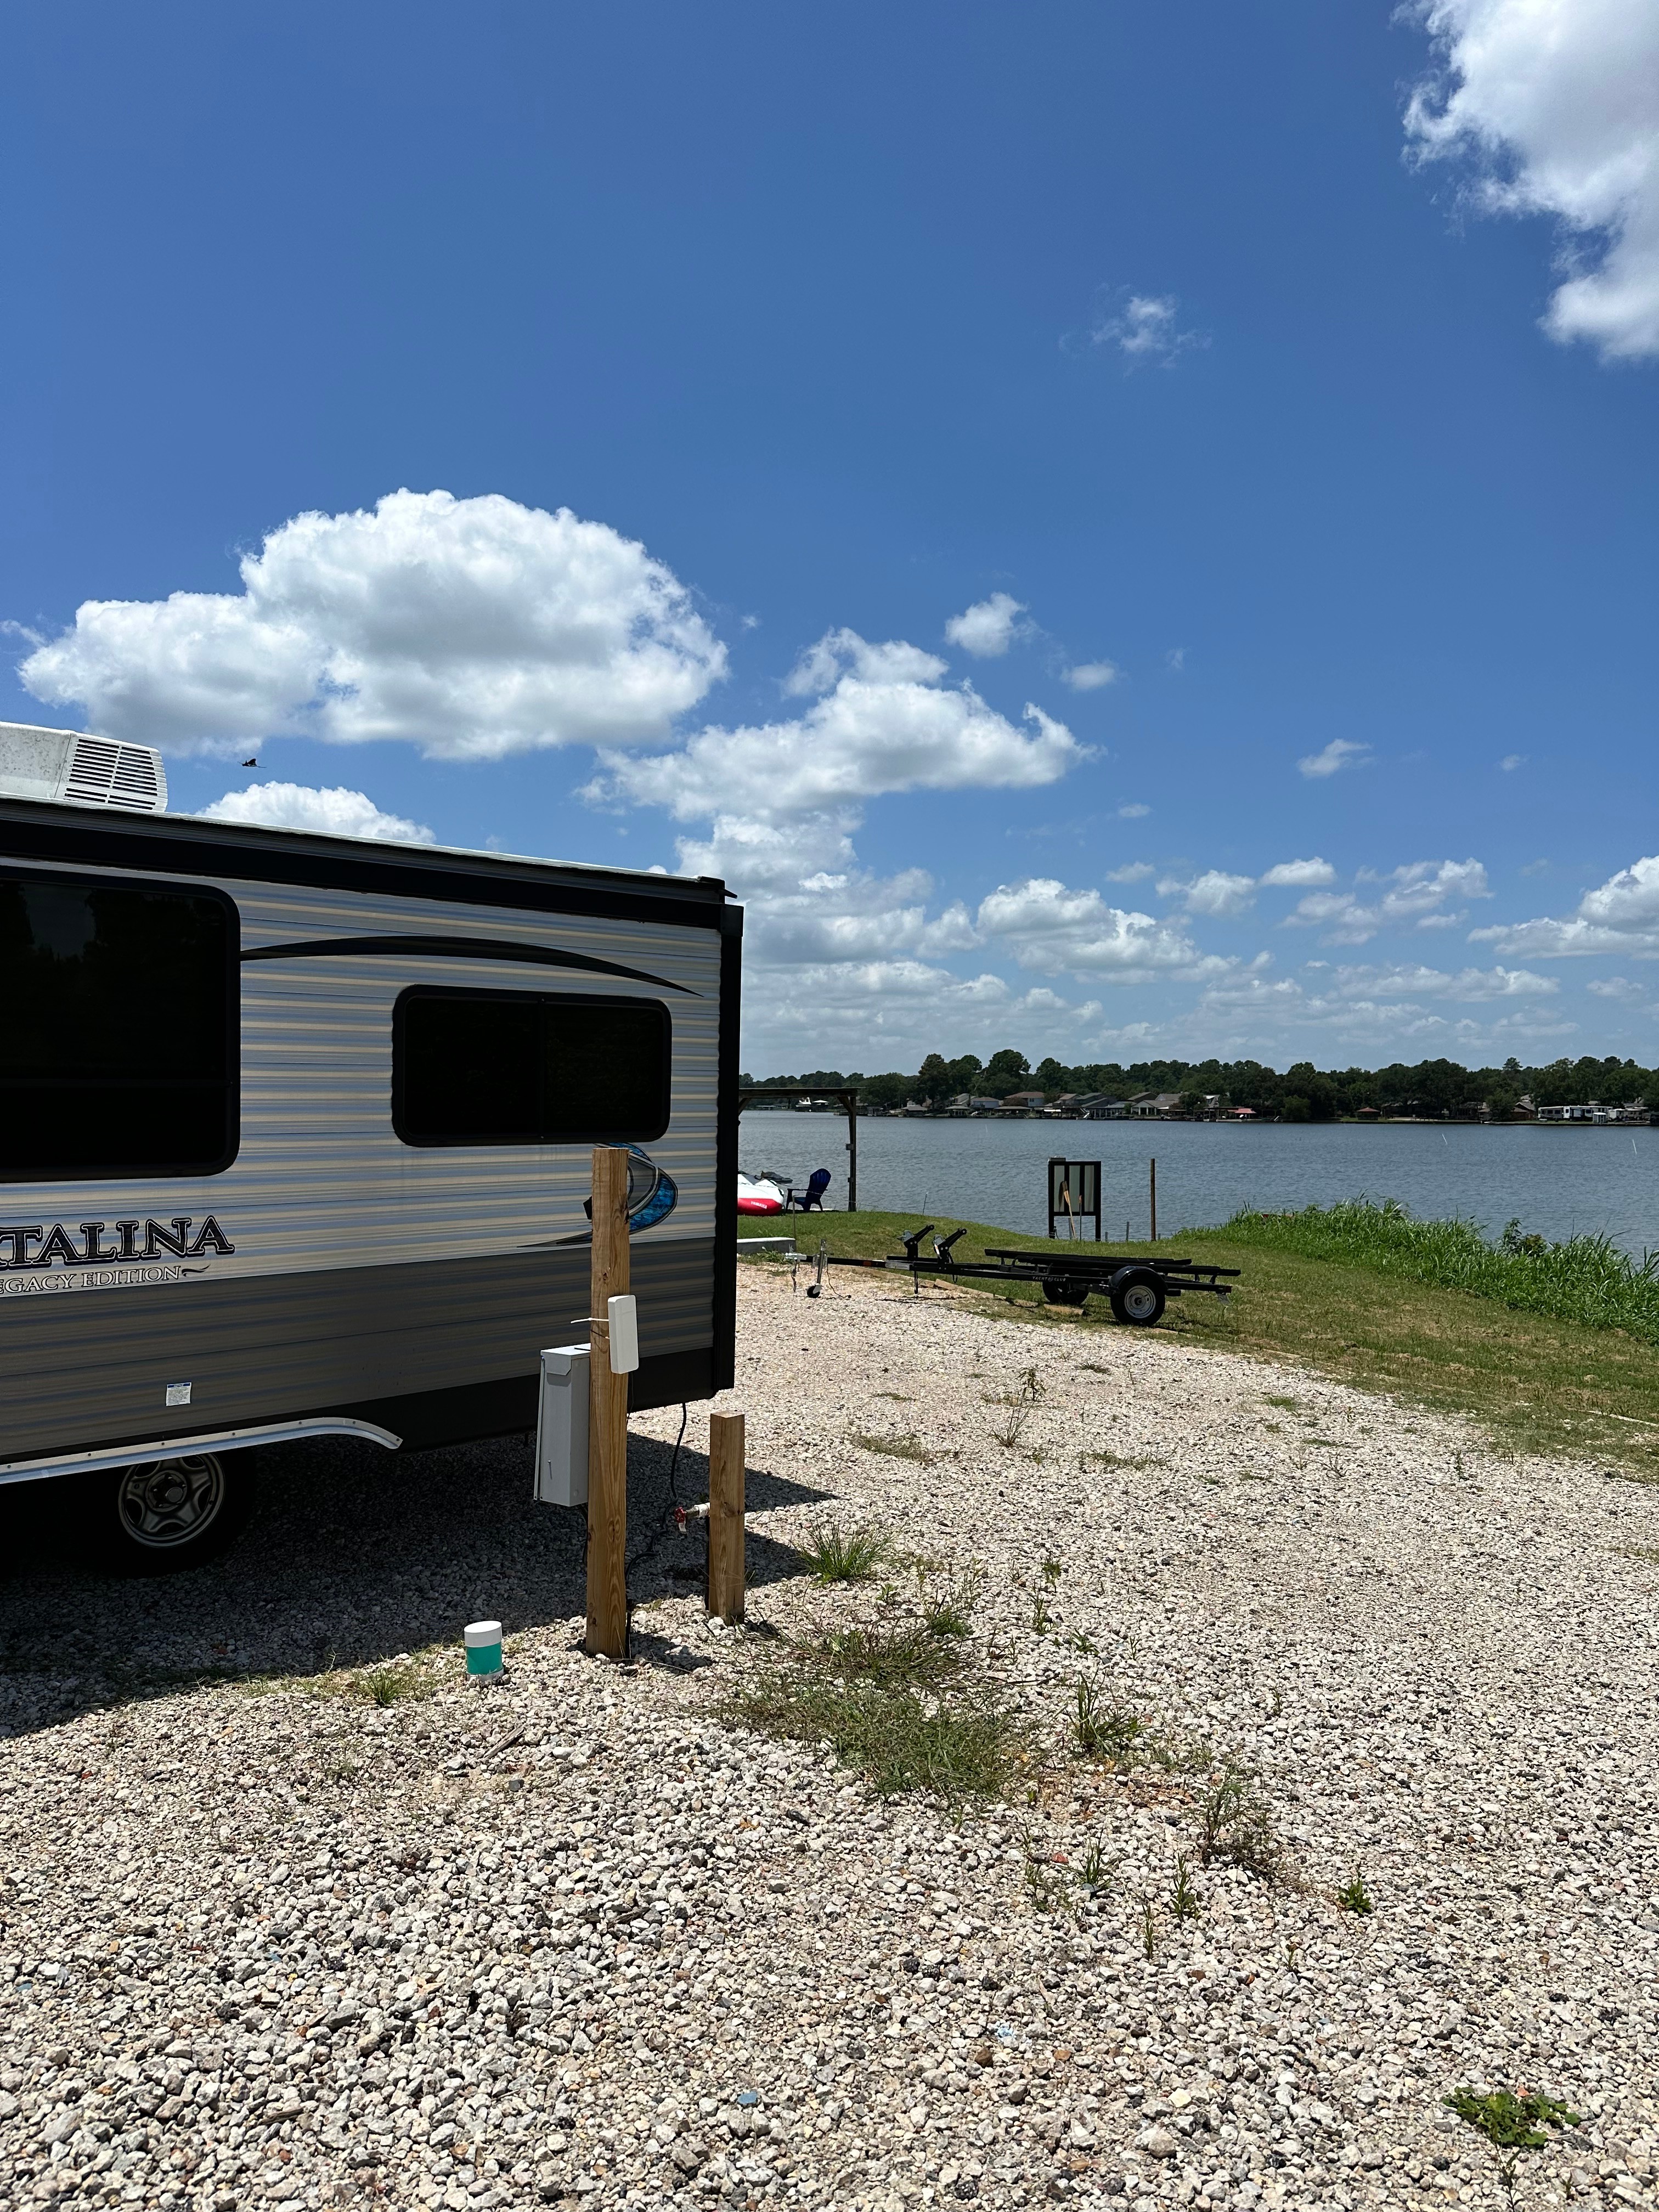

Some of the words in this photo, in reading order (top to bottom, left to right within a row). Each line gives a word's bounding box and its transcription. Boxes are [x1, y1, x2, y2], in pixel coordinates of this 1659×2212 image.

[751, 1201, 768, 1209] YAMAHA
[0, 1215, 235, 1271] TALINA
[81, 1266, 180, 1288] EDITION
